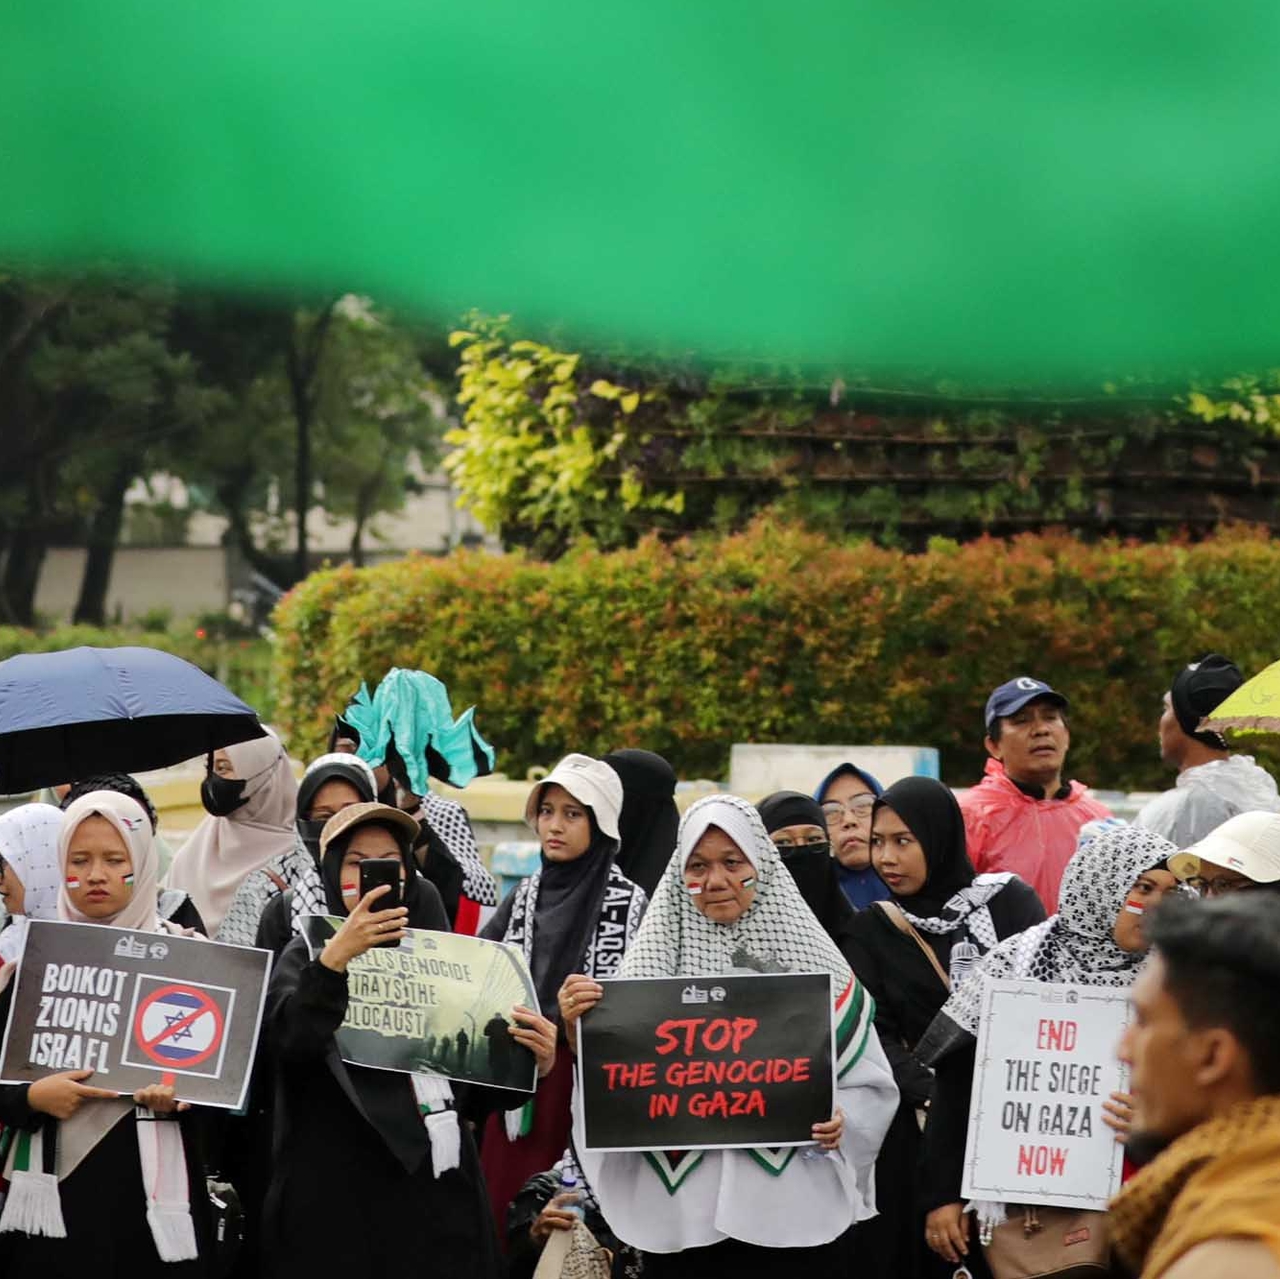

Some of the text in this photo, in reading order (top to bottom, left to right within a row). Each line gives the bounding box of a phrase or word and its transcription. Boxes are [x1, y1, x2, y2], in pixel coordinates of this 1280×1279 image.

[42, 963, 128, 1002] BOIKOT
[401, 954, 472, 982] GENOCIDE
[407, 980, 438, 1005] THE
[35, 996, 120, 1036] ZIONIS
[346, 1002, 425, 1036] OLOCAUST
[655, 1016, 760, 1057] STOP
[1036, 1019, 1078, 1052] END
[29, 1033, 109, 1074] ISRAEL
[602, 1057, 811, 1090] THE GENOCIDE
[1005, 1059, 1102, 1096] THE SIEGE
[648, 1090, 767, 1119] IN GAZA
[1001, 1101, 1093, 1138] ON GAZA
[1017, 1144, 1070, 1177] NOW
